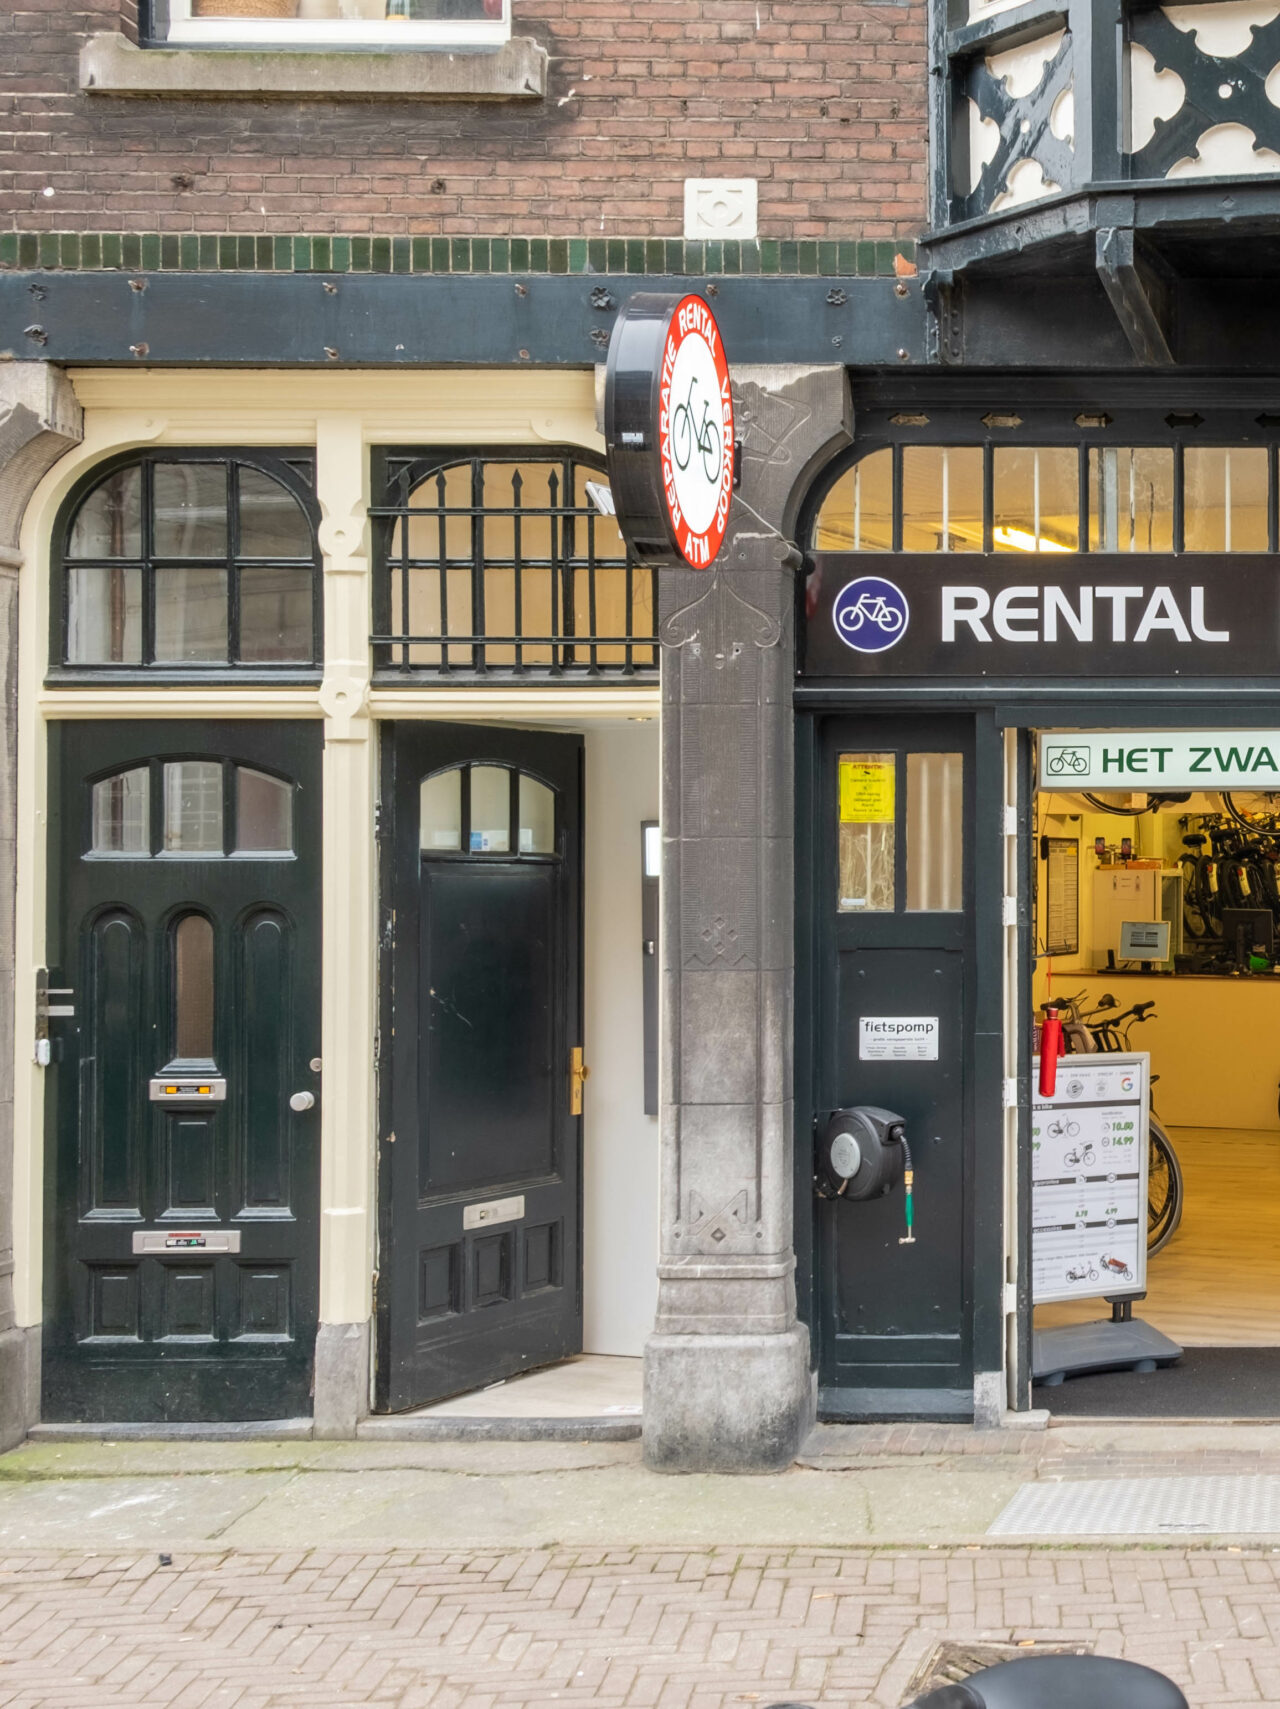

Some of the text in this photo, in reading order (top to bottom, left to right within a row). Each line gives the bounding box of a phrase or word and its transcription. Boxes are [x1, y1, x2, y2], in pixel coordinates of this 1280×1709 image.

[679, 303, 716, 357] RENTAL
[660, 335, 682, 530] REPARATIE
[717, 376, 733, 534] VERKOOP
[685, 532, 710, 564] ATM
[941, 585, 1230, 643] RENTAL
[1102, 748, 1173, 773] HET
[865, 1021, 934, 1035] fietspomp
